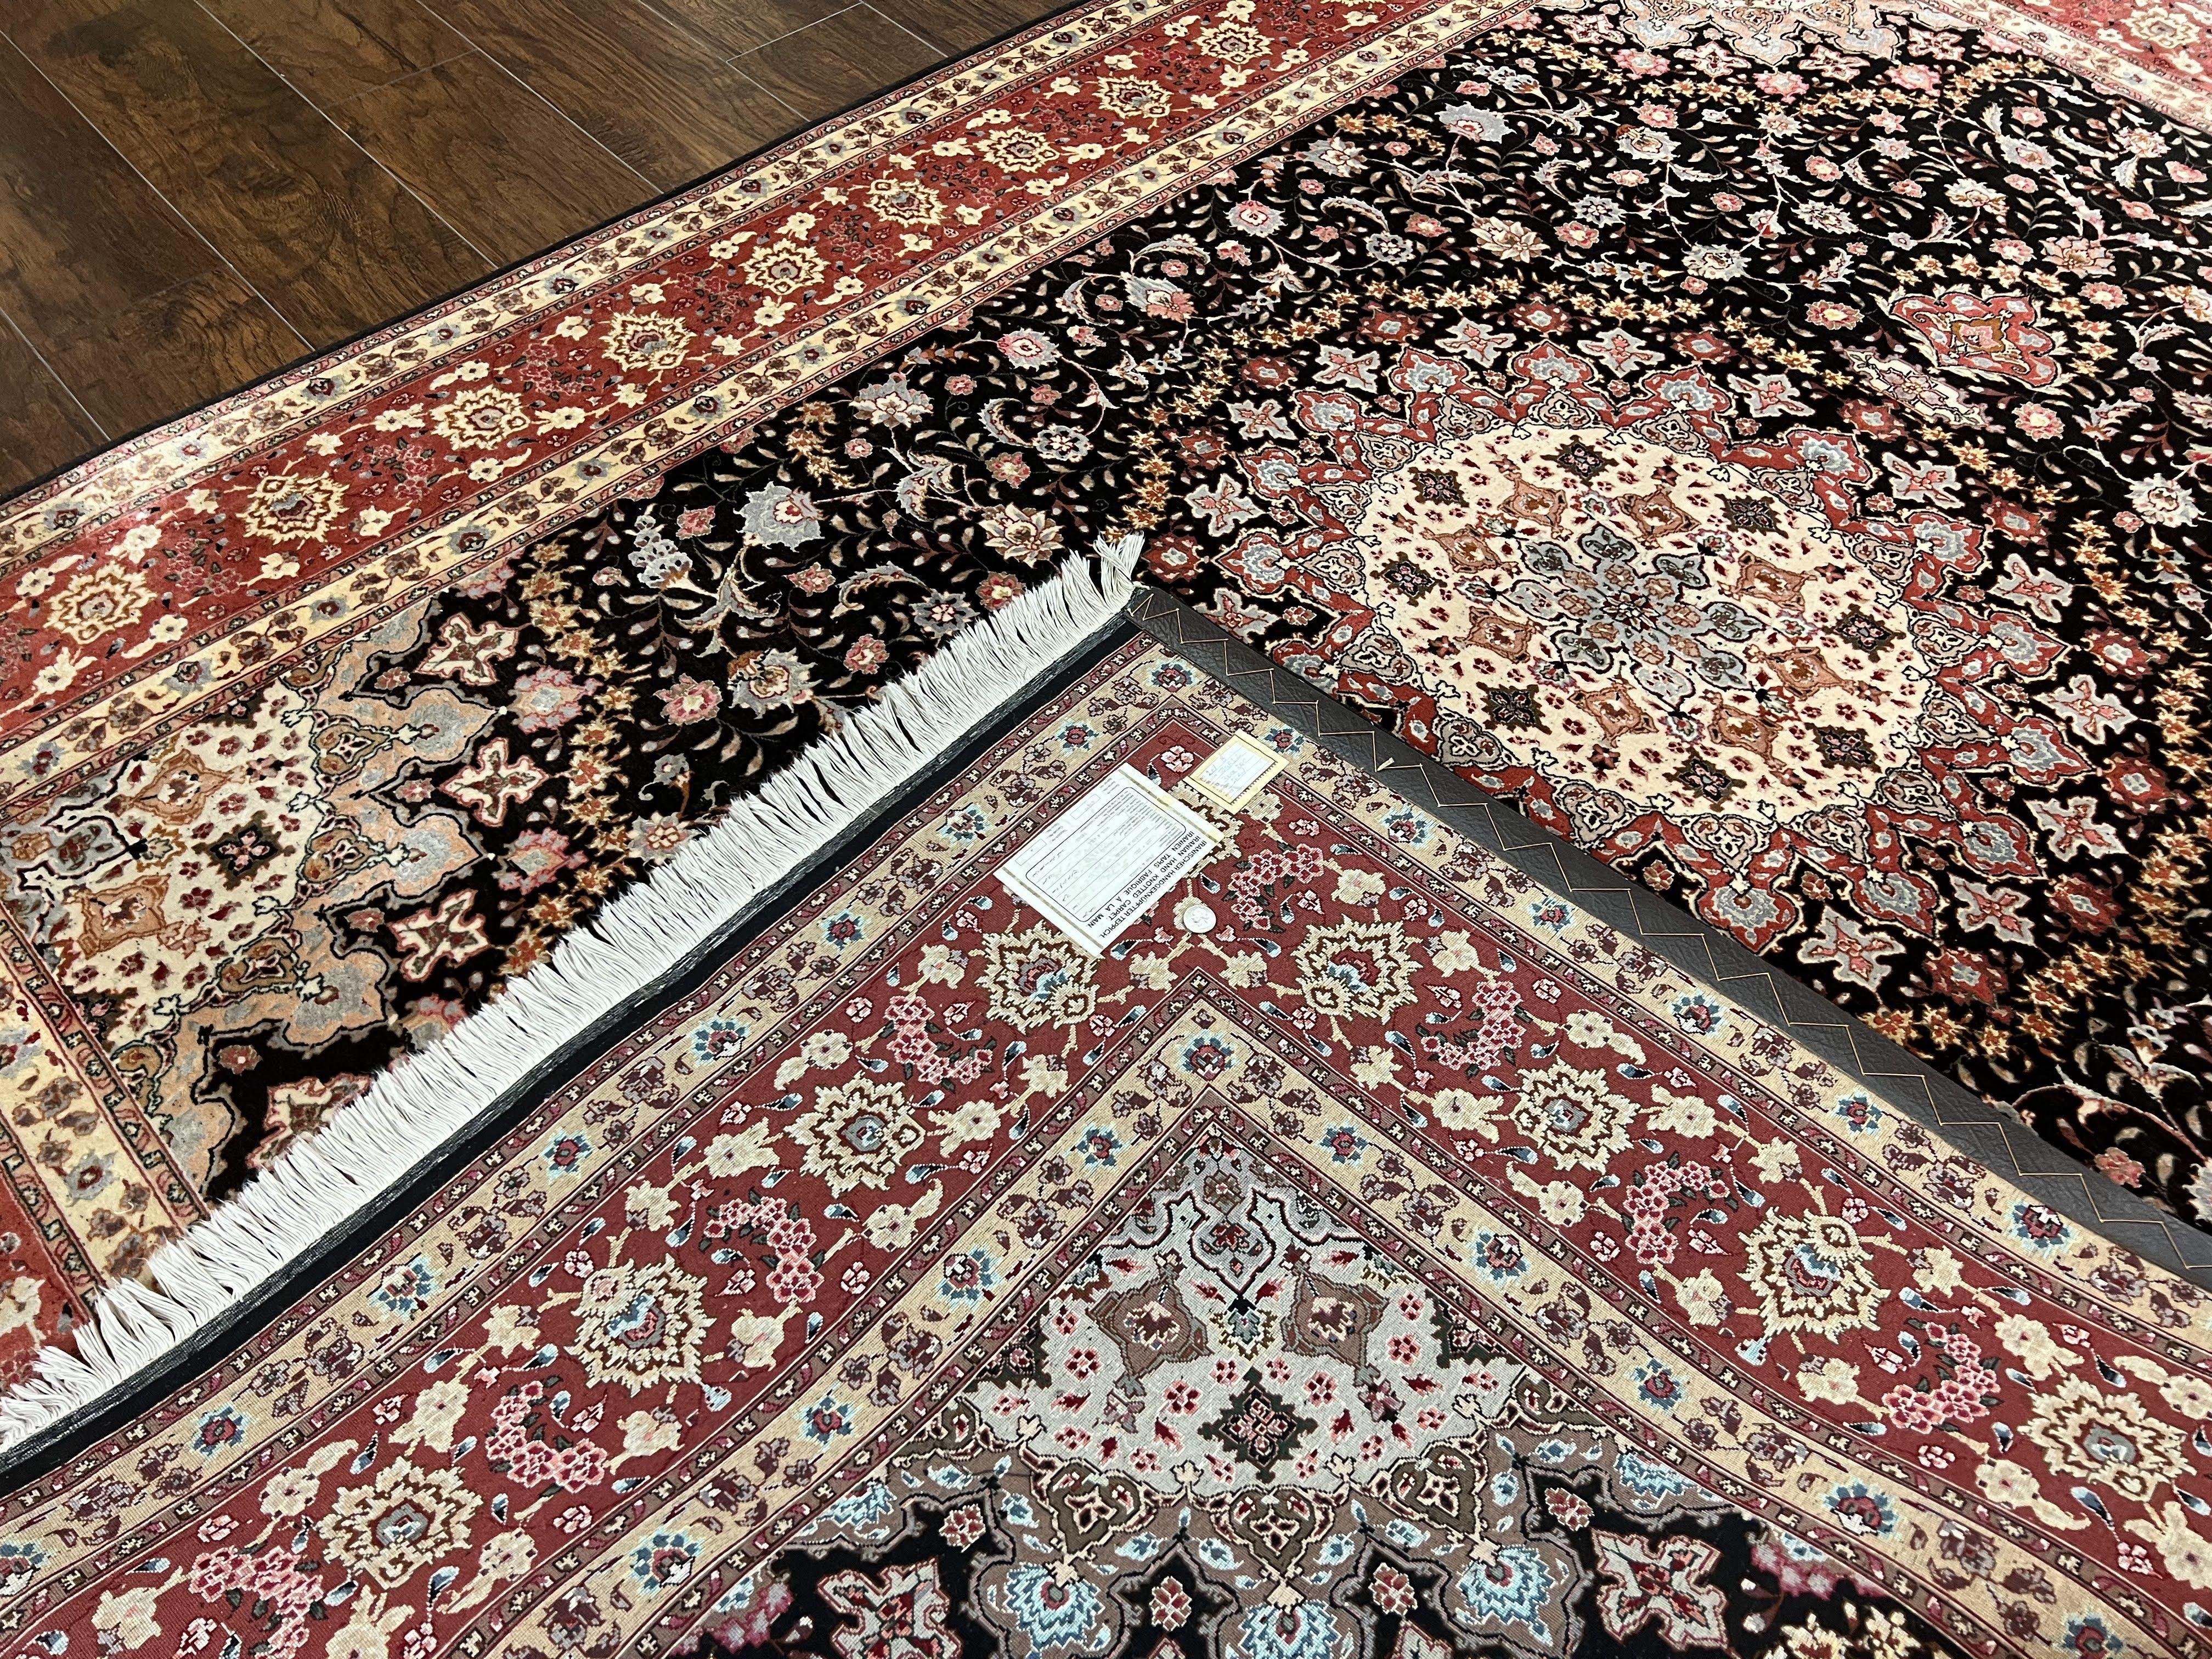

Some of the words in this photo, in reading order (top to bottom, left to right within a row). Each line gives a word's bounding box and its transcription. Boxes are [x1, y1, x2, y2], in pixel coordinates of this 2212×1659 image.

[1171, 831, 1194, 851] IRANIEN
[1178, 836, 1201, 856] IRANIAN
[1154, 854, 1171, 867] TAPIS
[1160, 857, 1177, 872] HAND
[1174, 840, 1207, 870] IRANISCHER
[1123, 870, 1152, 895] FABRIQUE
[1124, 870, 1176, 916] HANDGEKNÜPFTER
[1133, 874, 1159, 898] KNOTTED
